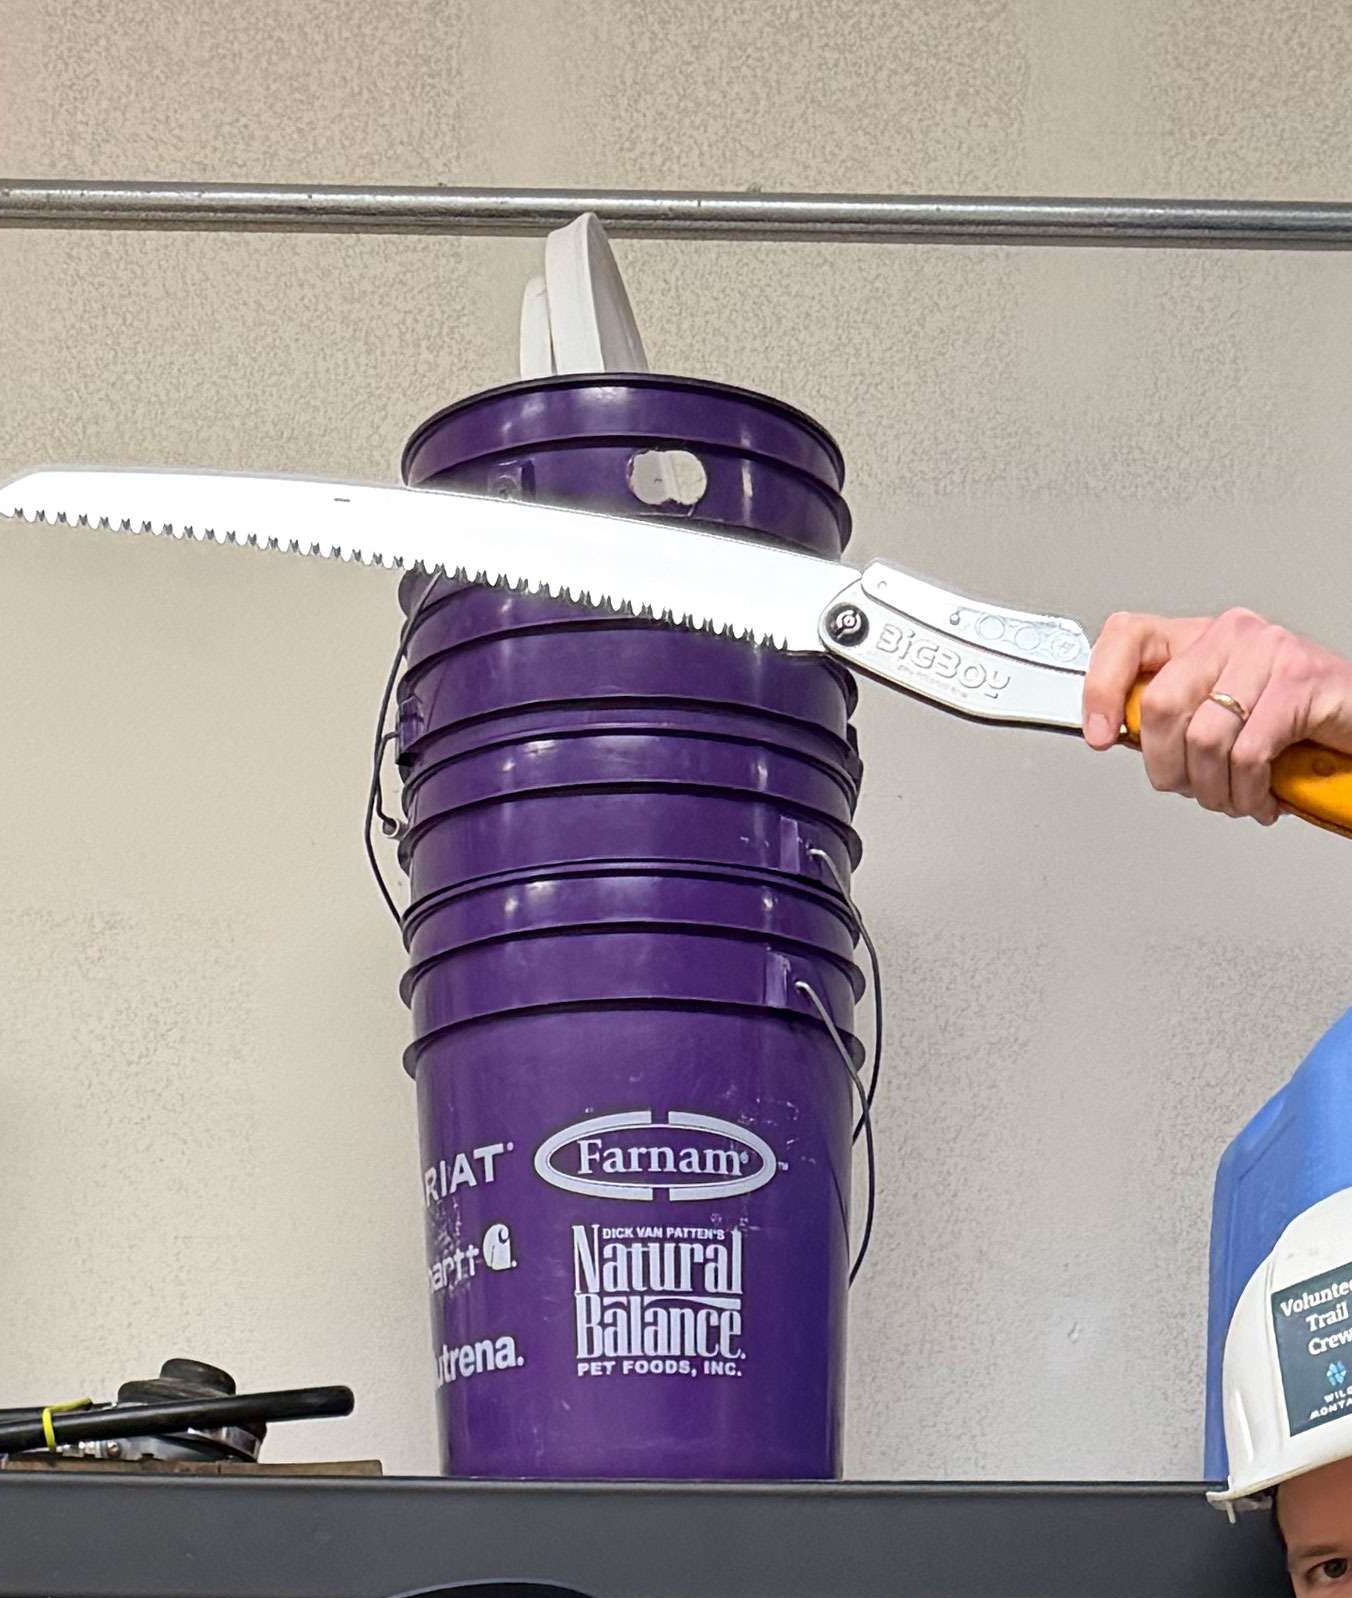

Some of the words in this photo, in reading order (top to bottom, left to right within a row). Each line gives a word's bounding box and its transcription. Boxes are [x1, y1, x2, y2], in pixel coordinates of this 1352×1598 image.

[423, 1142, 506, 1204] RIAT
[576, 1138, 744, 1177] Farnam
[603, 1227, 634, 1240] DICK
[636, 1227, 663, 1240] VAN
[666, 1226, 726, 1241] PATTEN'S
[572, 1223, 744, 1296] Natural
[1305, 1302, 1349, 1332] Trail
[577, 1362, 616, 1377] PET
[622, 1361, 697, 1378] FOODS,
[703, 1362, 742, 1377] INC.
